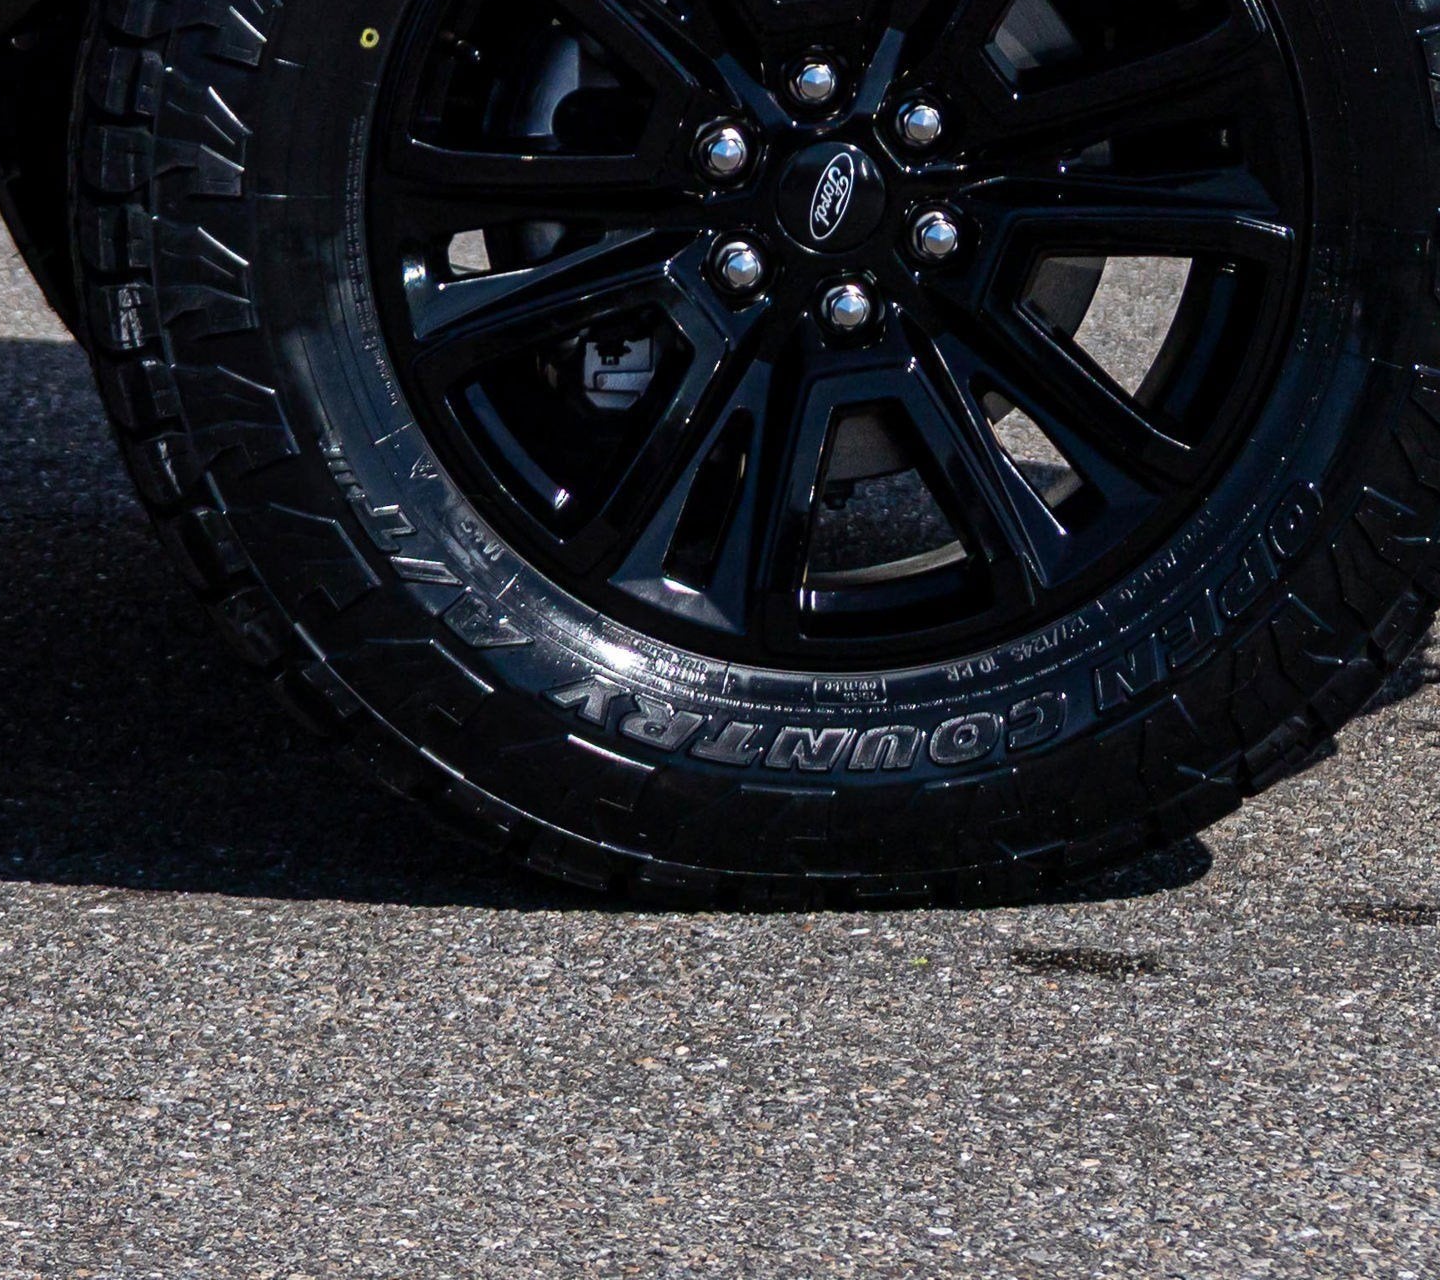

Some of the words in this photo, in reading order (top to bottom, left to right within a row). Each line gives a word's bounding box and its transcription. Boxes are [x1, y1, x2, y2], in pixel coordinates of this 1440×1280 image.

[814, 166, 849, 227] Ford
[1095, 481, 1324, 711] OPEN
[541, 676, 1068, 772] COUNTRY
